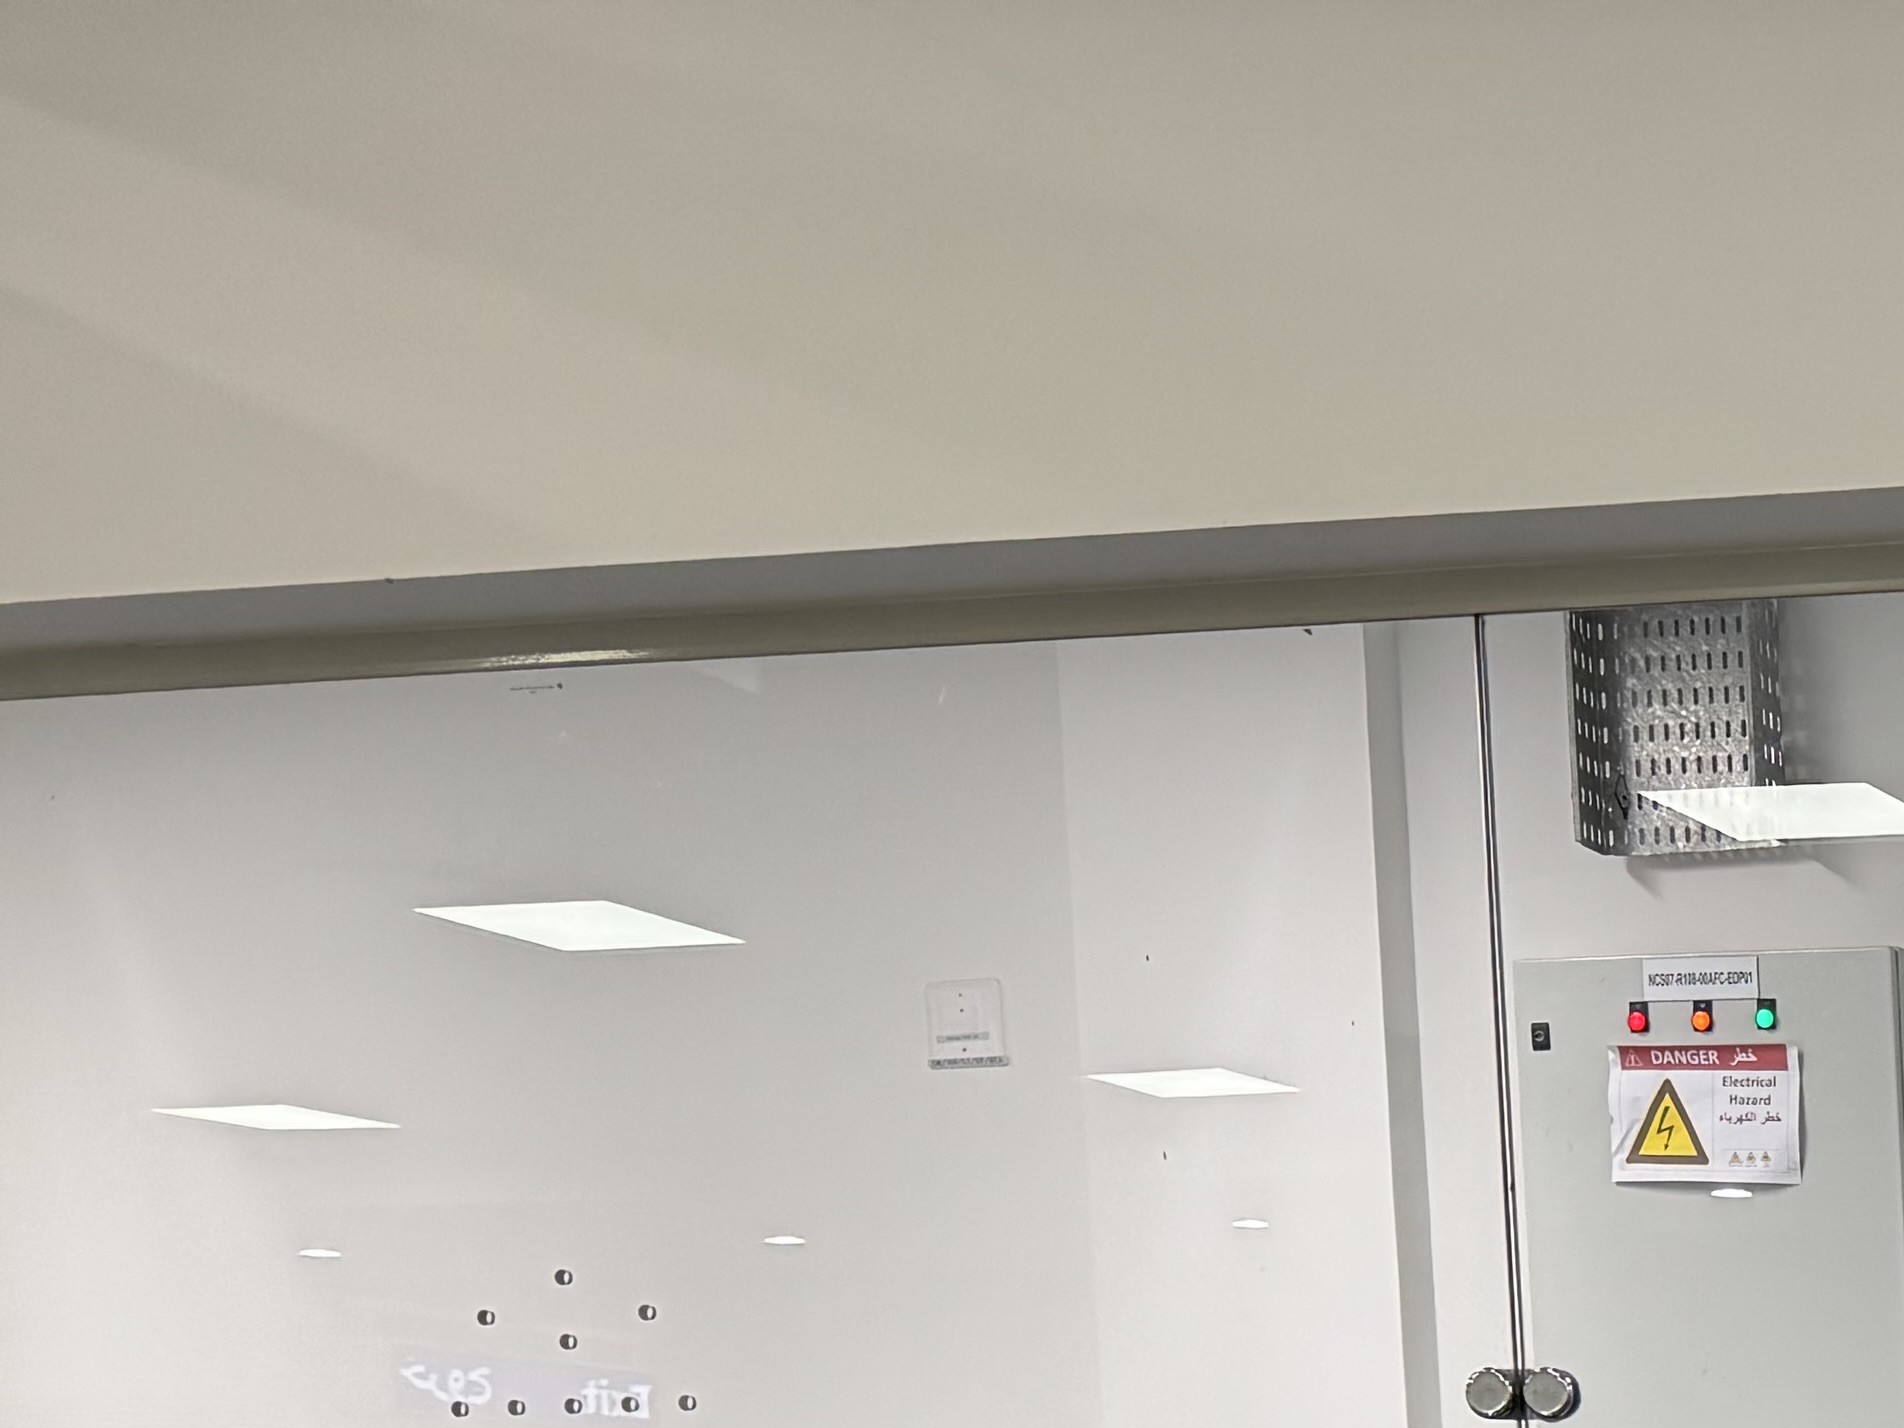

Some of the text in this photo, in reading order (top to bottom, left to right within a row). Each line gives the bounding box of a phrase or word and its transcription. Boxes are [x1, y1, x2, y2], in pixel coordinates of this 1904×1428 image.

[1651, 1050, 1719, 1065] DANGER
[1729, 1047, 1758, 1066] خطر
[1722, 1076, 1777, 1088] Electrical
[1729, 1094, 1772, 1106] Hazard
[1719, 1111, 1782, 1125] خطر الكهرباء
